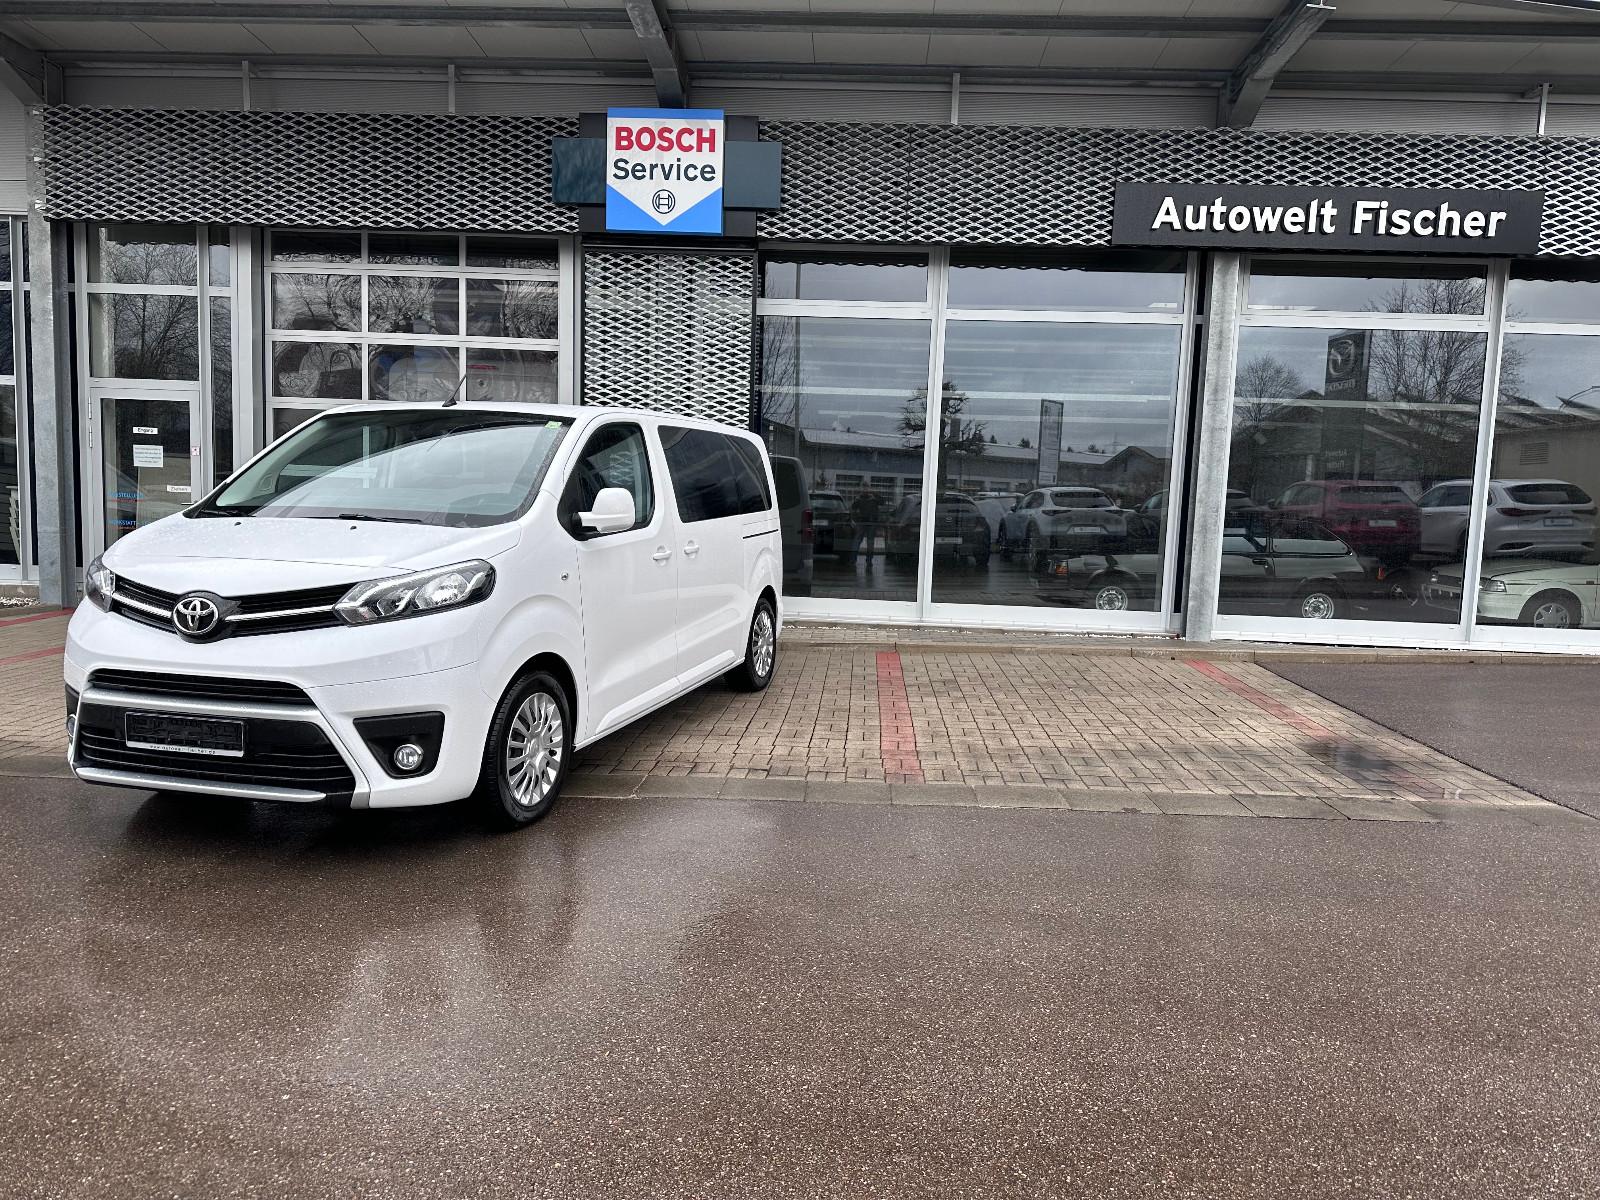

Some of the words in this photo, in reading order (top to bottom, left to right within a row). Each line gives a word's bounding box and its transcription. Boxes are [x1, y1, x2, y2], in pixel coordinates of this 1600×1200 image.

[615, 126, 716, 153] BOSCH
[612, 157, 716, 181] Service
[1151, 196, 1338, 235] Autowelt
[1353, 200, 1507, 237] Fischer
